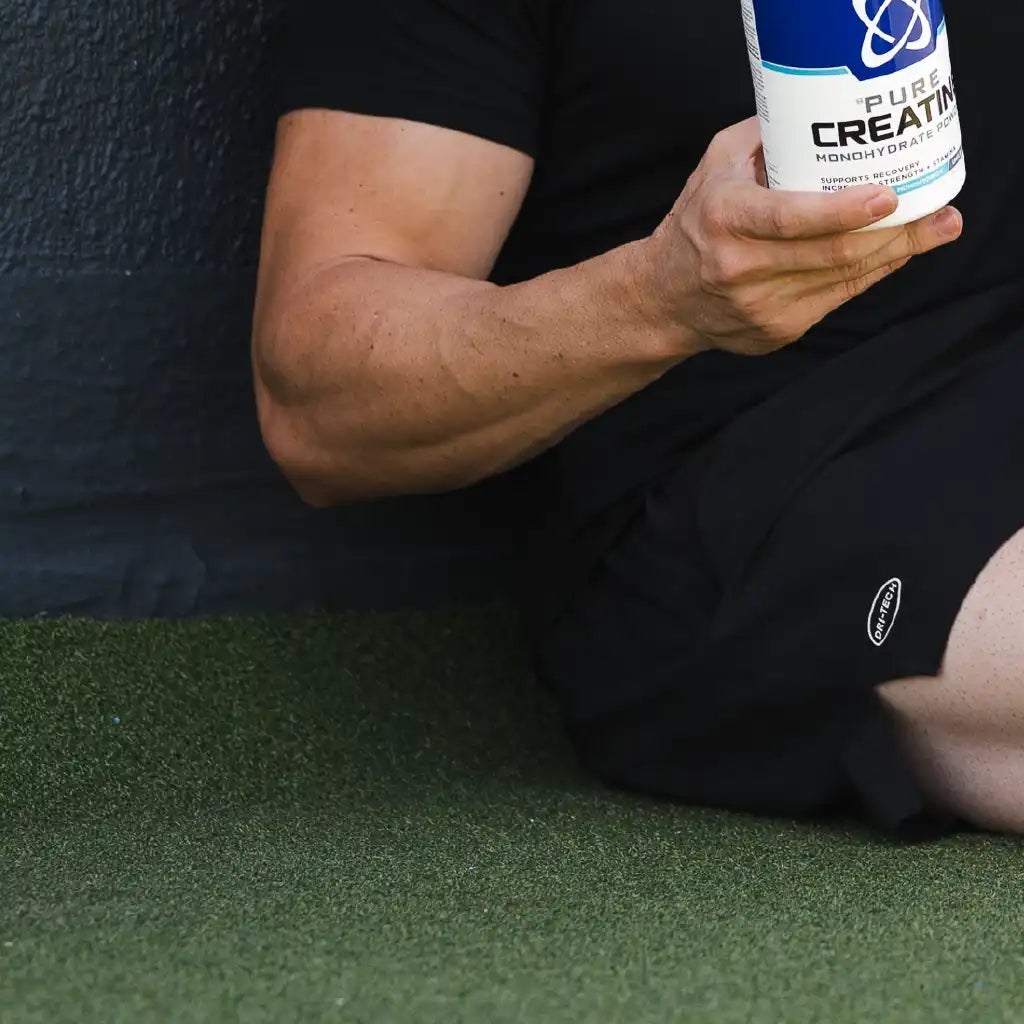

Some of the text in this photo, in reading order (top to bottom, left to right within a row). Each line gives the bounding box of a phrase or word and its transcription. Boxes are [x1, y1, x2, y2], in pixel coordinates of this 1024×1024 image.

[811, 76, 954, 148] CREATIN
[865, 68, 940, 113] PURE
[816, 128, 934, 163] MONOHYDRATE
[821, 174, 870, 184] SUPPORTS
[873, 160, 920, 180] RECOVERY
[874, 582, 897, 640] DRI-TECH
